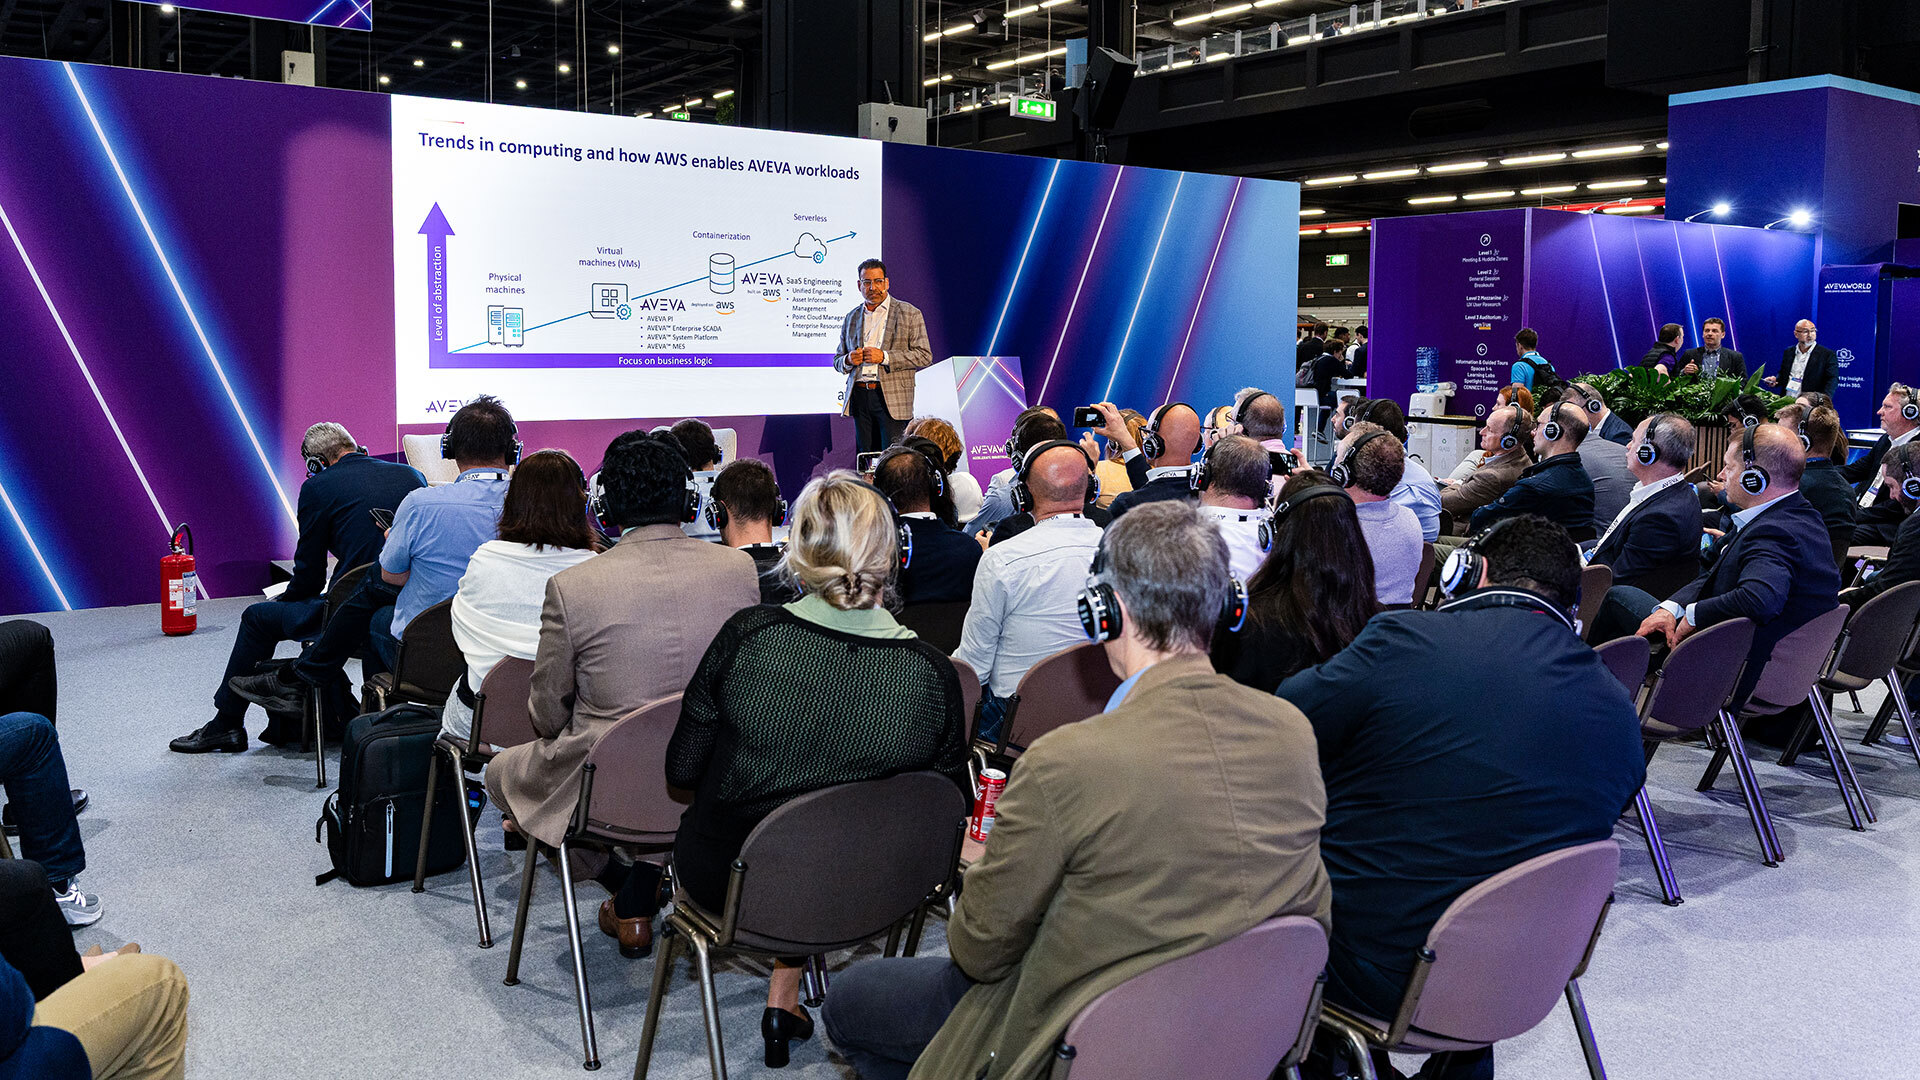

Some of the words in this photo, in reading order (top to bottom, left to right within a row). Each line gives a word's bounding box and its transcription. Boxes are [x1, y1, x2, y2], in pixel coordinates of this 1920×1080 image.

[418, 132, 474, 150] Trends
[479, 136, 494, 152] in
[499, 140, 582, 162] computing
[587, 147, 614, 161] and
[619, 148, 650, 164] how
[654, 152, 688, 167] AWS
[692, 156, 744, 171] enables
[748, 159, 792, 175] AVEVA
[794, 164, 860, 180] workloads
[794, 212, 828, 223] Serverless
[692, 230, 751, 241] Containerization
[597, 247, 623, 256] Virtual
[579, 258, 616, 267] machines
[618, 259, 641, 269] (VMs)
[433, 246, 443, 301] abstraction
[488, 273, 522, 282] Physical
[741, 272, 784, 286] AVEVA
[786, 277, 802, 285] SaaS
[804, 278, 842, 287] Engineering
[486, 285, 526, 295] machines
[763, 289, 781, 297] aws
[813, 288, 842, 296] Engineering
[433, 303, 443, 314] of
[640, 298, 686, 312] AVEVA
[716, 301, 735, 310] aws
[433, 316, 443, 341] Level
[618, 356, 643, 365] Focus
[658, 356, 692, 365] business
[694, 356, 713, 366] logic
[426, 400, 469, 413] AVEV
